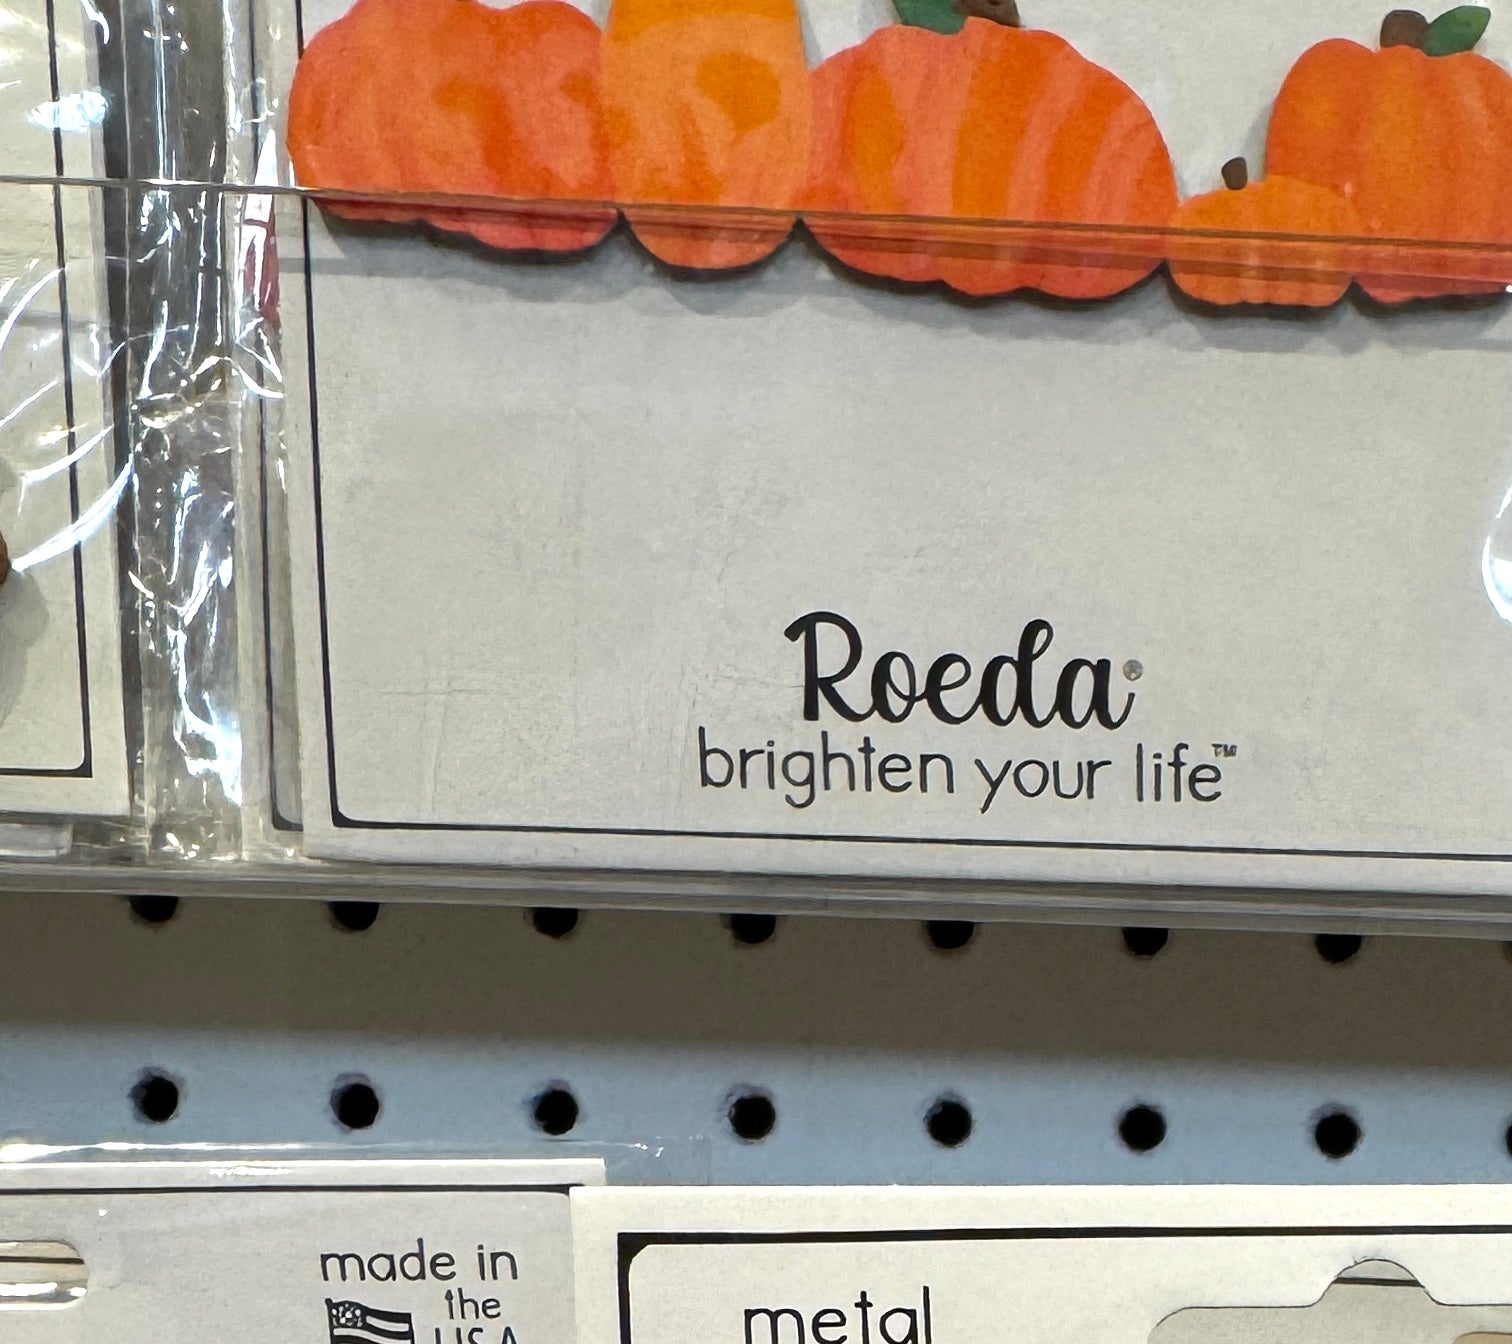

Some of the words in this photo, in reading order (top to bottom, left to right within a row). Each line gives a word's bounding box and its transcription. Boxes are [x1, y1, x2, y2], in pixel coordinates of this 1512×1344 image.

[698, 726, 955, 810] brighten
[975, 758, 1112, 815] your
[320, 1238, 457, 1282] made
[478, 1244, 519, 1281] in
[445, 1288, 502, 1320] the
